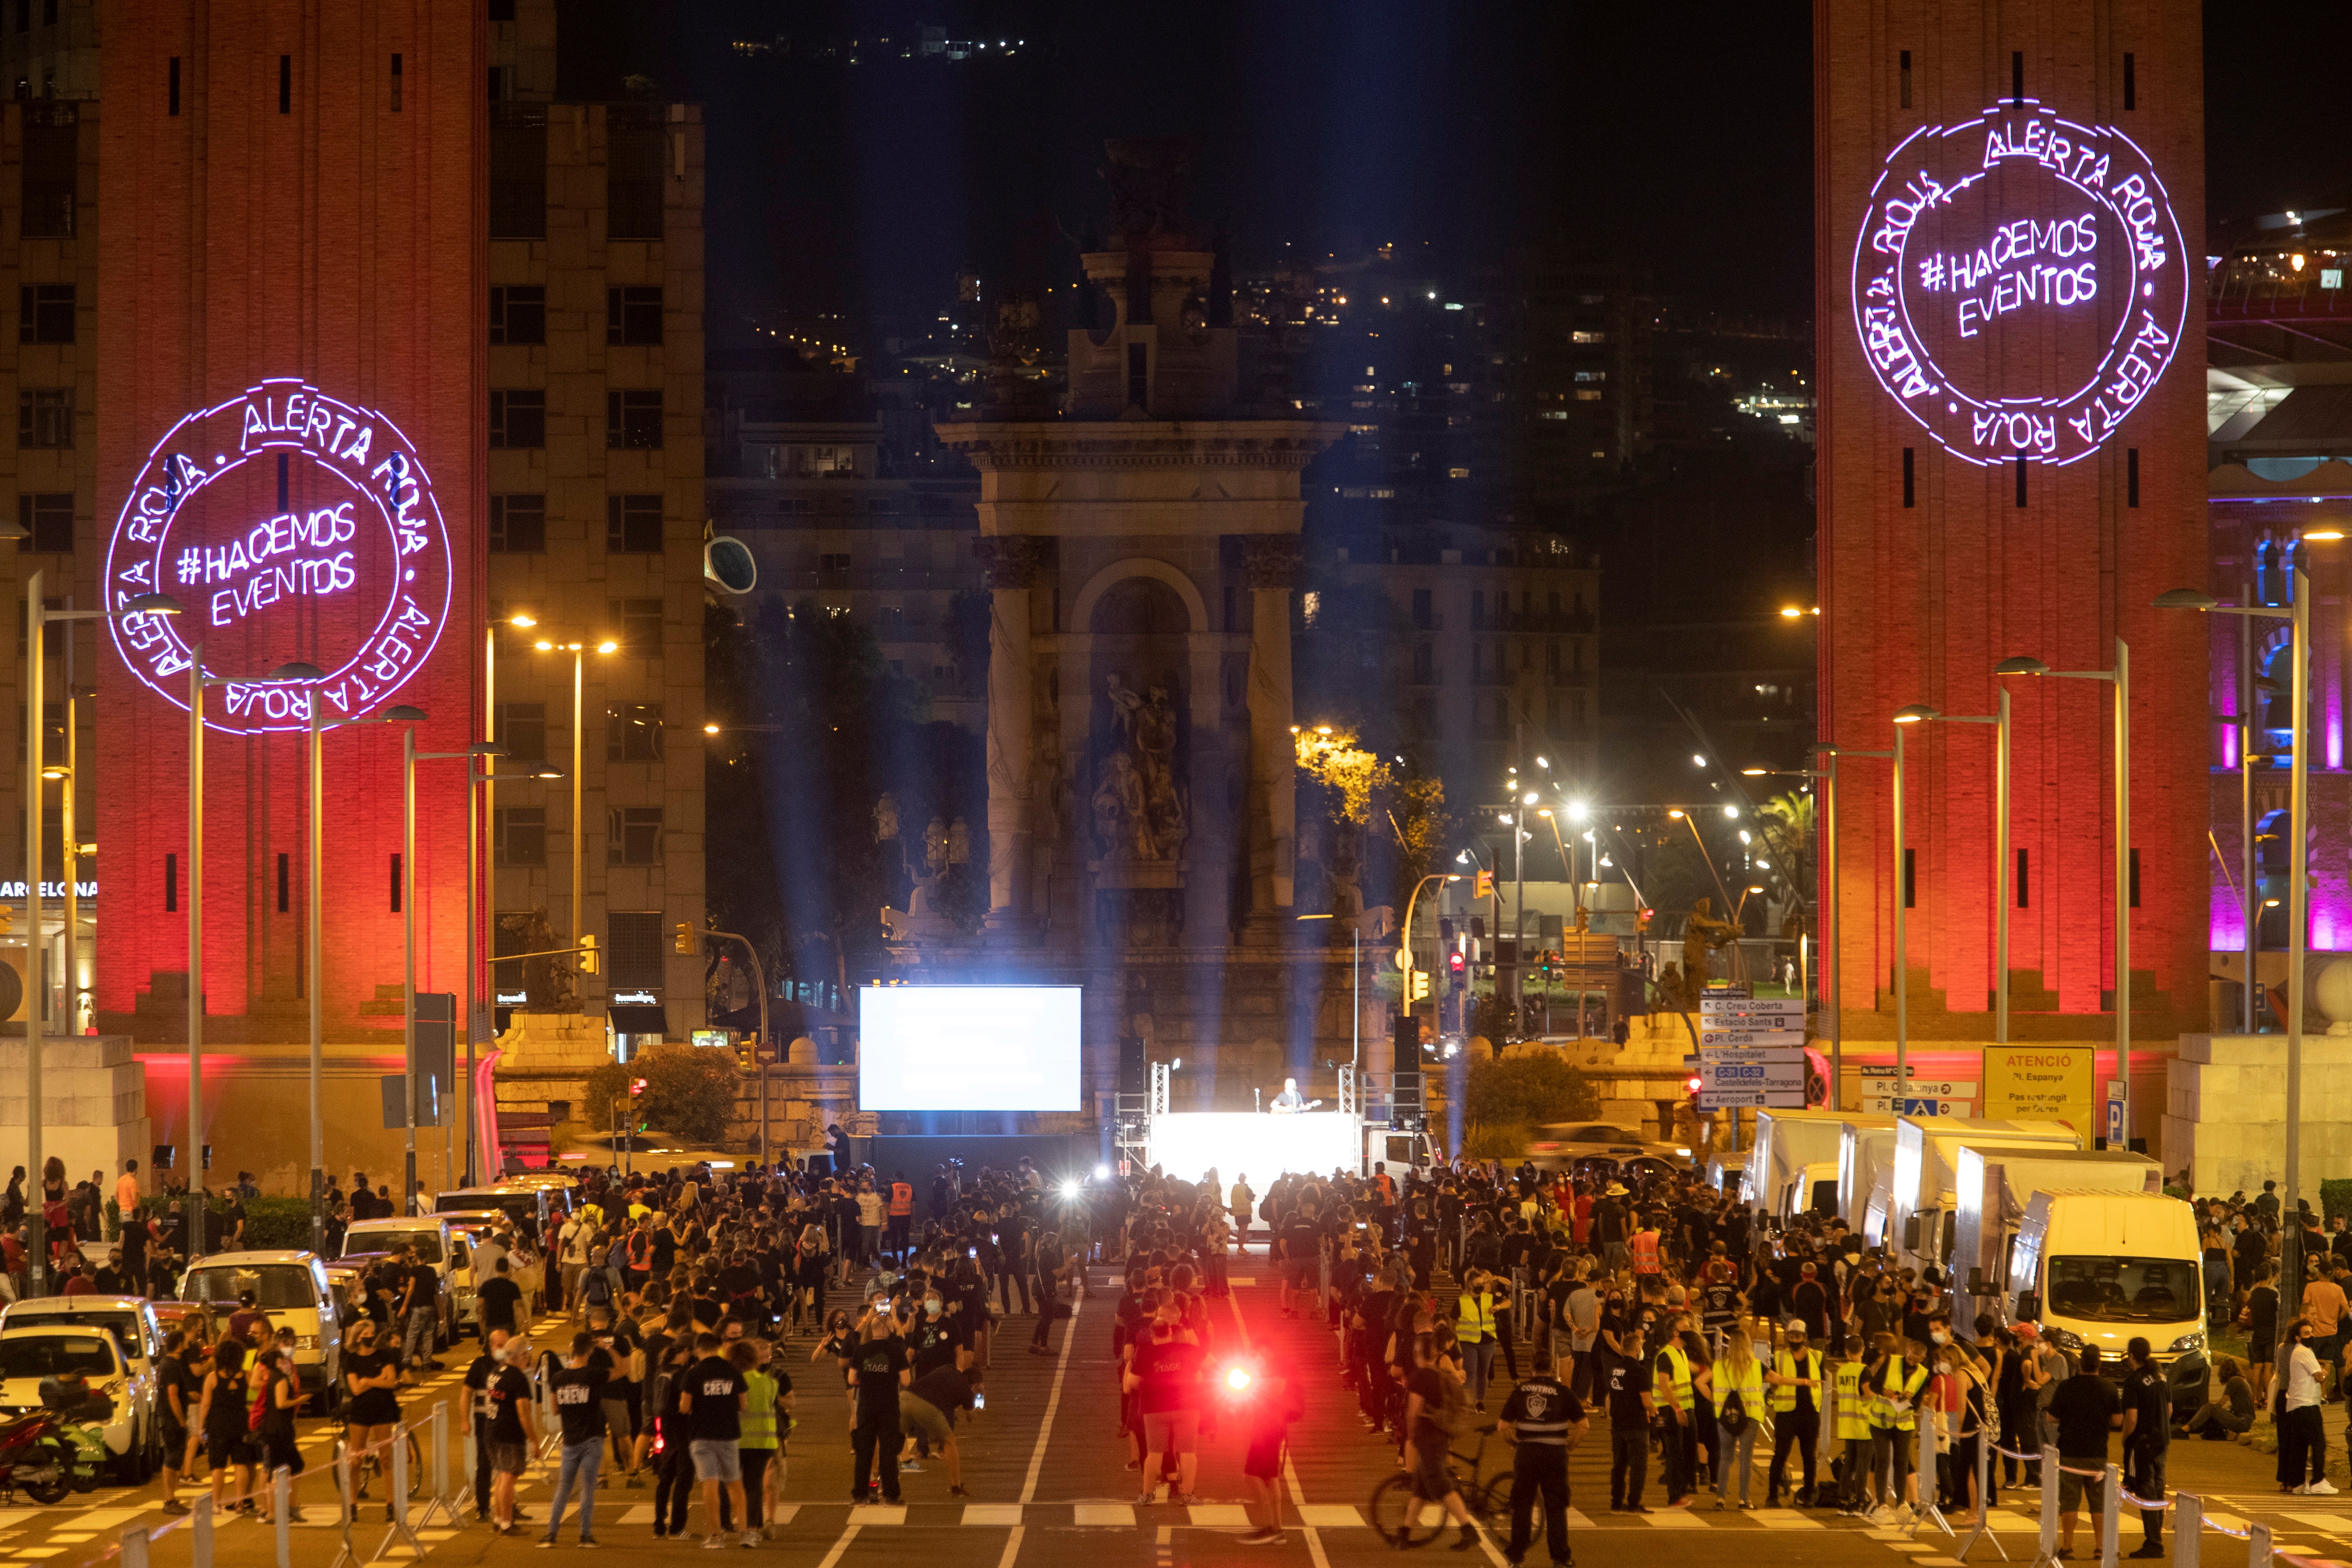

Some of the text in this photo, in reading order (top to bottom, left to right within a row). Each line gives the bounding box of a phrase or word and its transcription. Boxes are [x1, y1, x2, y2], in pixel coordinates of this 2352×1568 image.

[1984, 120, 2166, 270] ALERTA ROJA
[1919, 213, 2097, 292] #HACEMOS
[1959, 262, 2097, 338] EVENTOS
[1973, 310, 2170, 453] ALERTA ROJA
[240, 394, 429, 556] ALERTA ROJA
[128, 454, 207, 543] ROJA
[178, 502, 355, 586] #HACEMOS
[212, 552, 355, 627] EVENTOS
[226, 595, 431, 720] ALERTA ROJA
[0, 881, 98, 897] ARELONA
[1715, 1002, 1724, 1010] C.
[1749, 1001, 1782, 1010] Coberta
[1715, 1017, 1772, 1027] Estació Sants
[1715, 1034, 1753, 1043] Pl. Cerdà
[1715, 1050, 1766, 1060] L'Hospitalet
[2007, 1053, 2071, 1067] ATENCIÓ
[1715, 1078, 1802, 1088] Castelldefels-Tarragona
[2027, 1073, 2063, 1083] Espanya
[1877, 1082, 1939, 1094] Pl. Ctalunya
[1715, 1095, 1753, 1104] Aeroport
[1877, 1101, 1888, 1110] Pl.
[2110, 1105, 2121, 1140] P
[557, 1387, 590, 1404] CREW
[704, 1381, 733, 1395] CREW
[1521, 1385, 1558, 1395] CONTROL
